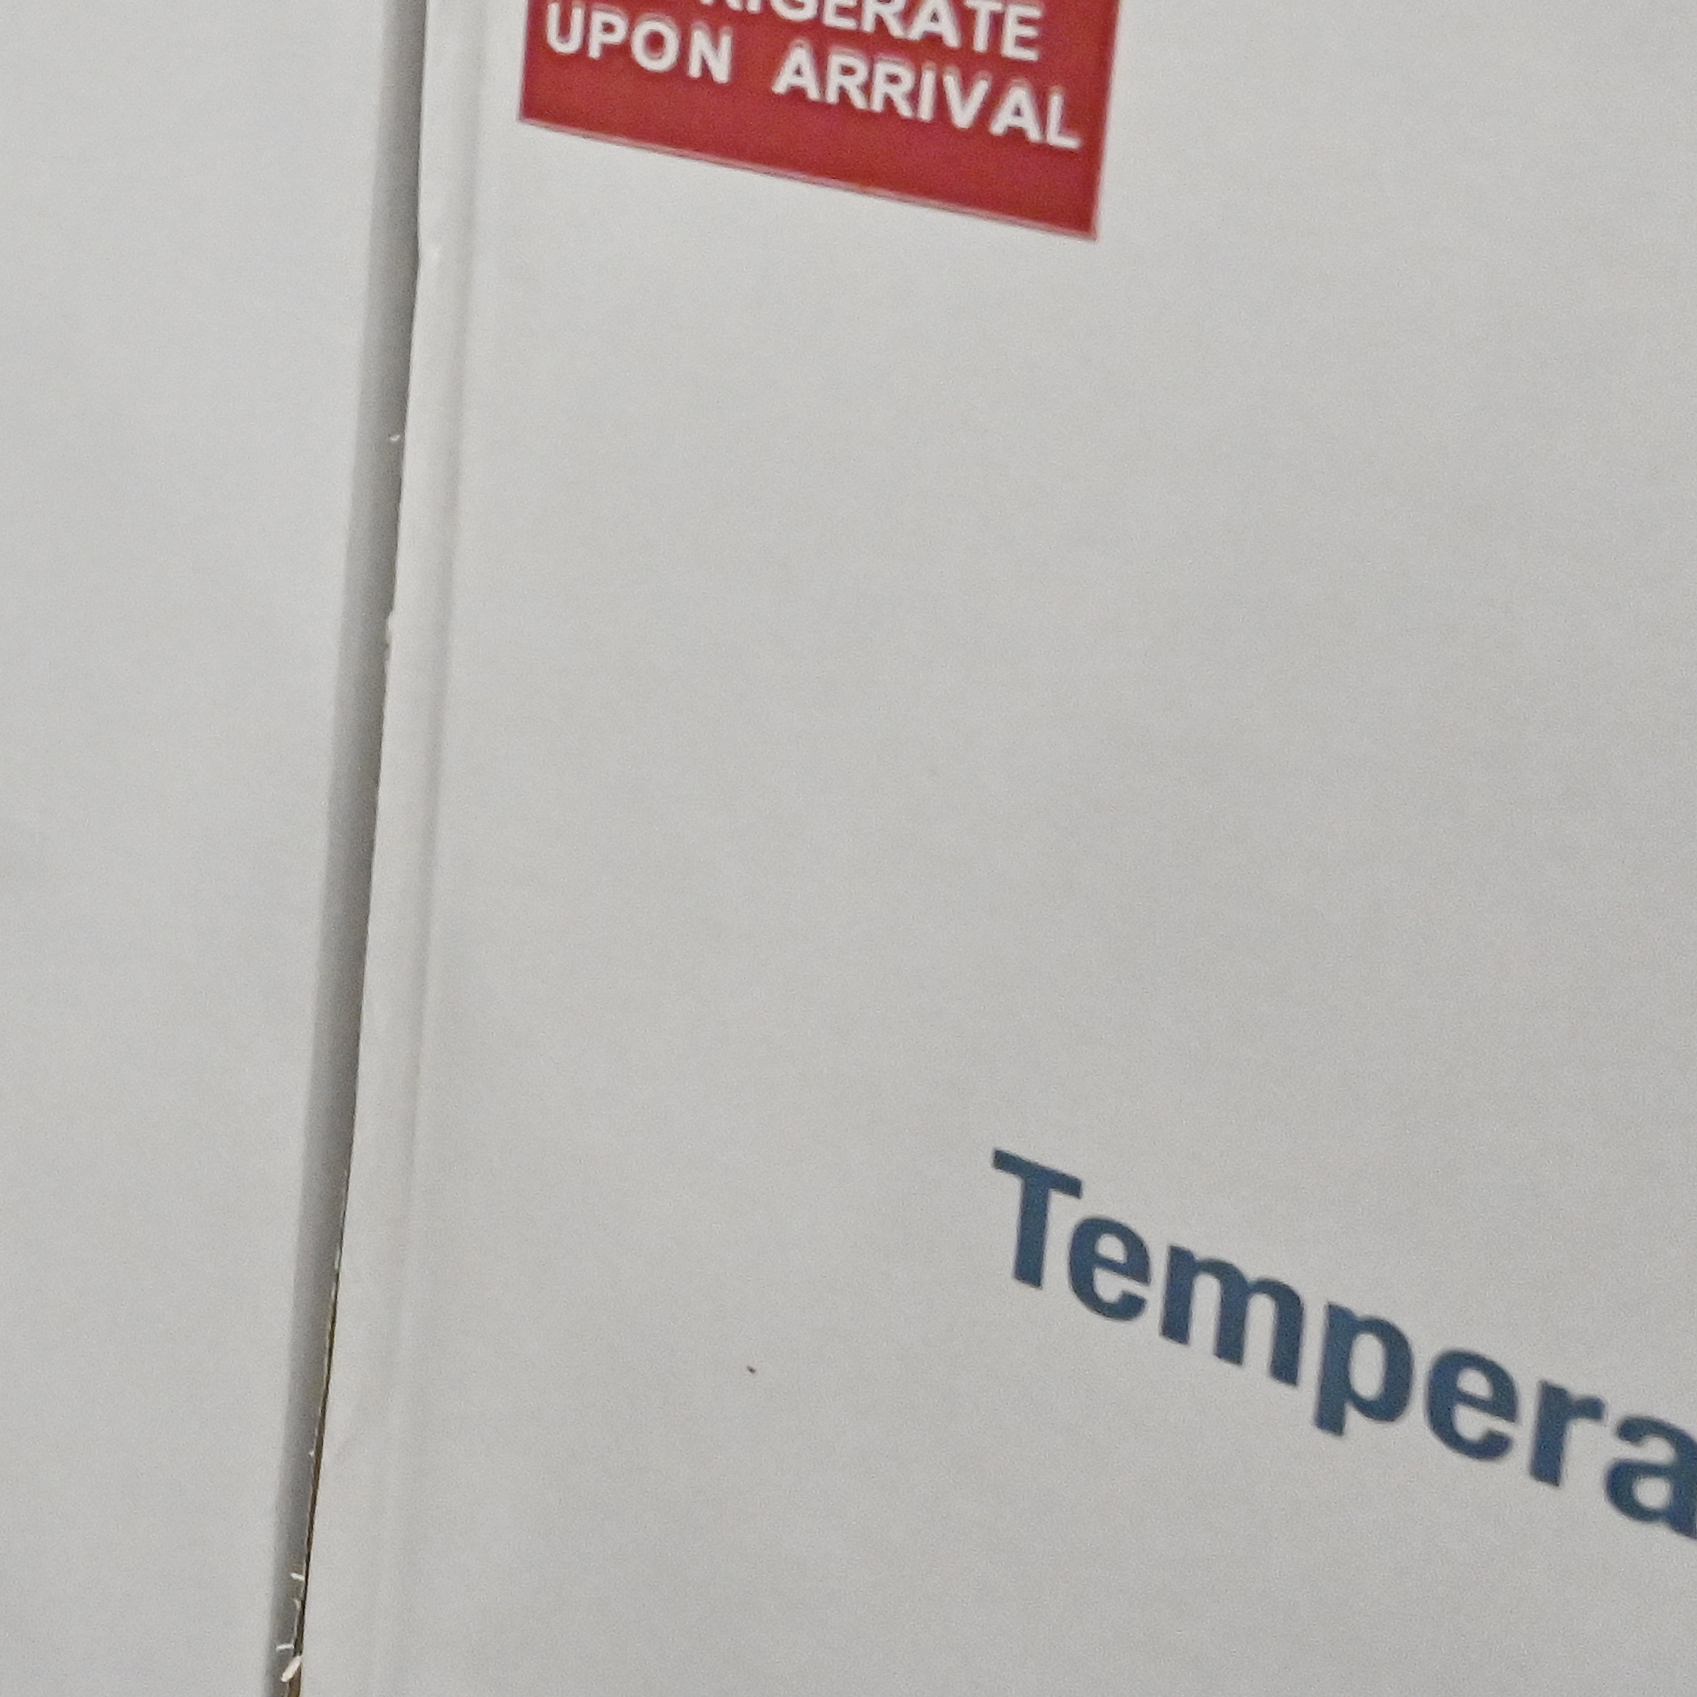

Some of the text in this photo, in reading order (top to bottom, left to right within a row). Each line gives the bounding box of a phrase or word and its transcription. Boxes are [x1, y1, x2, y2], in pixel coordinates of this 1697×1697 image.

[545, 0, 1082, 151] UPON ARRIVAL
[991, 1147, 1697, 1542] Tempera
